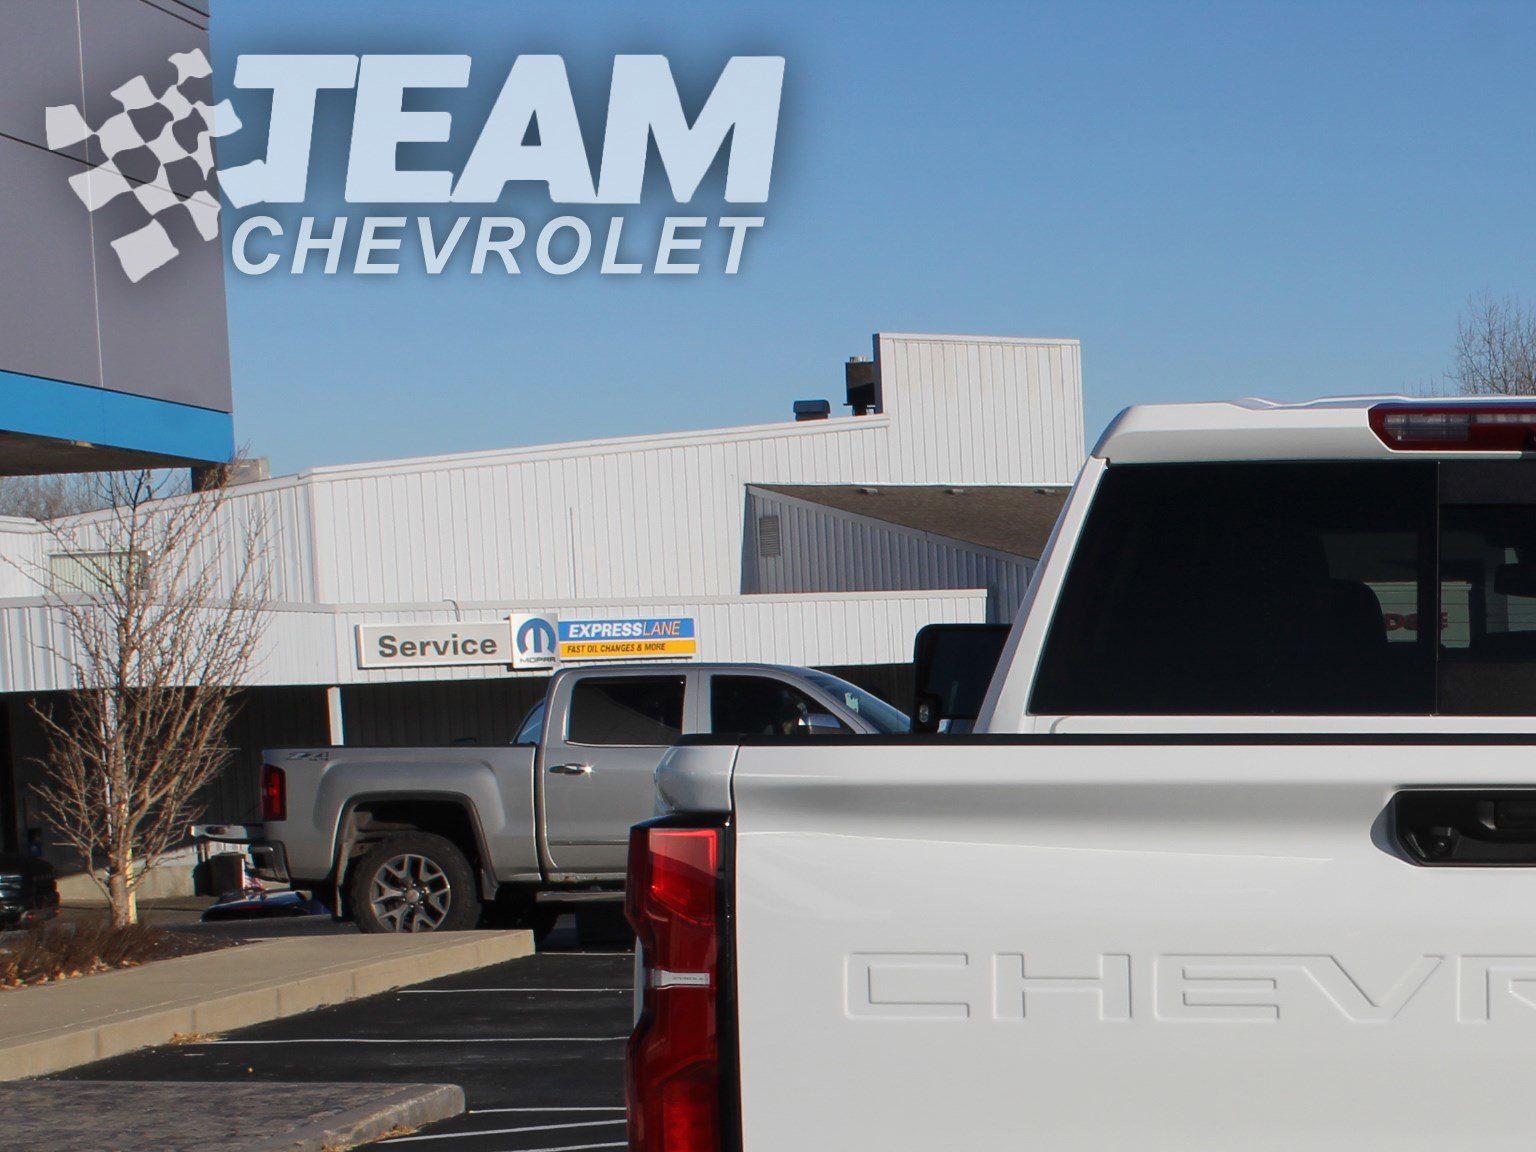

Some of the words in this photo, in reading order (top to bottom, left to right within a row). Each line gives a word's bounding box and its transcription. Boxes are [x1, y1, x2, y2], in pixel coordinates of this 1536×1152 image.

[378, 633, 498, 659] Service
[567, 645, 585, 653] FAST
[587, 645, 599, 653] OIL
[600, 643, 635, 652] CHANGES
[636, 643, 642, 651] &
[644, 642, 666, 651] MORE
